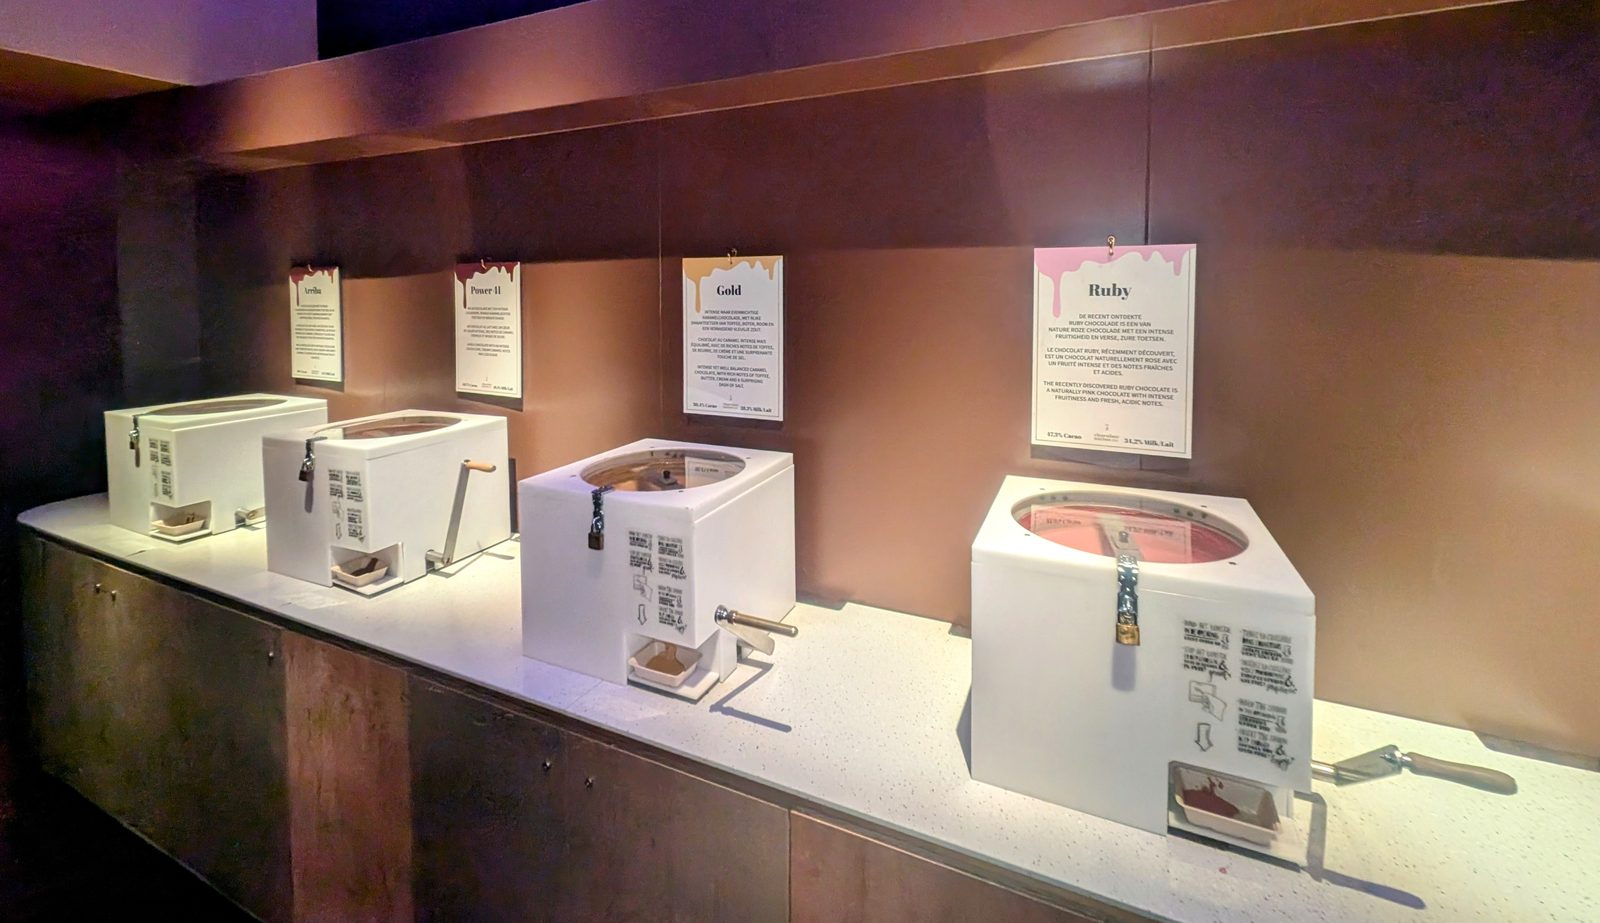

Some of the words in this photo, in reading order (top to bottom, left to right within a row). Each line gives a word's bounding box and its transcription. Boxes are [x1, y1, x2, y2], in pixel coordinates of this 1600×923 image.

[471, 286, 492, 294] Power
[717, 285, 742, 296] Gold
[1088, 283, 1132, 300] Ruby
